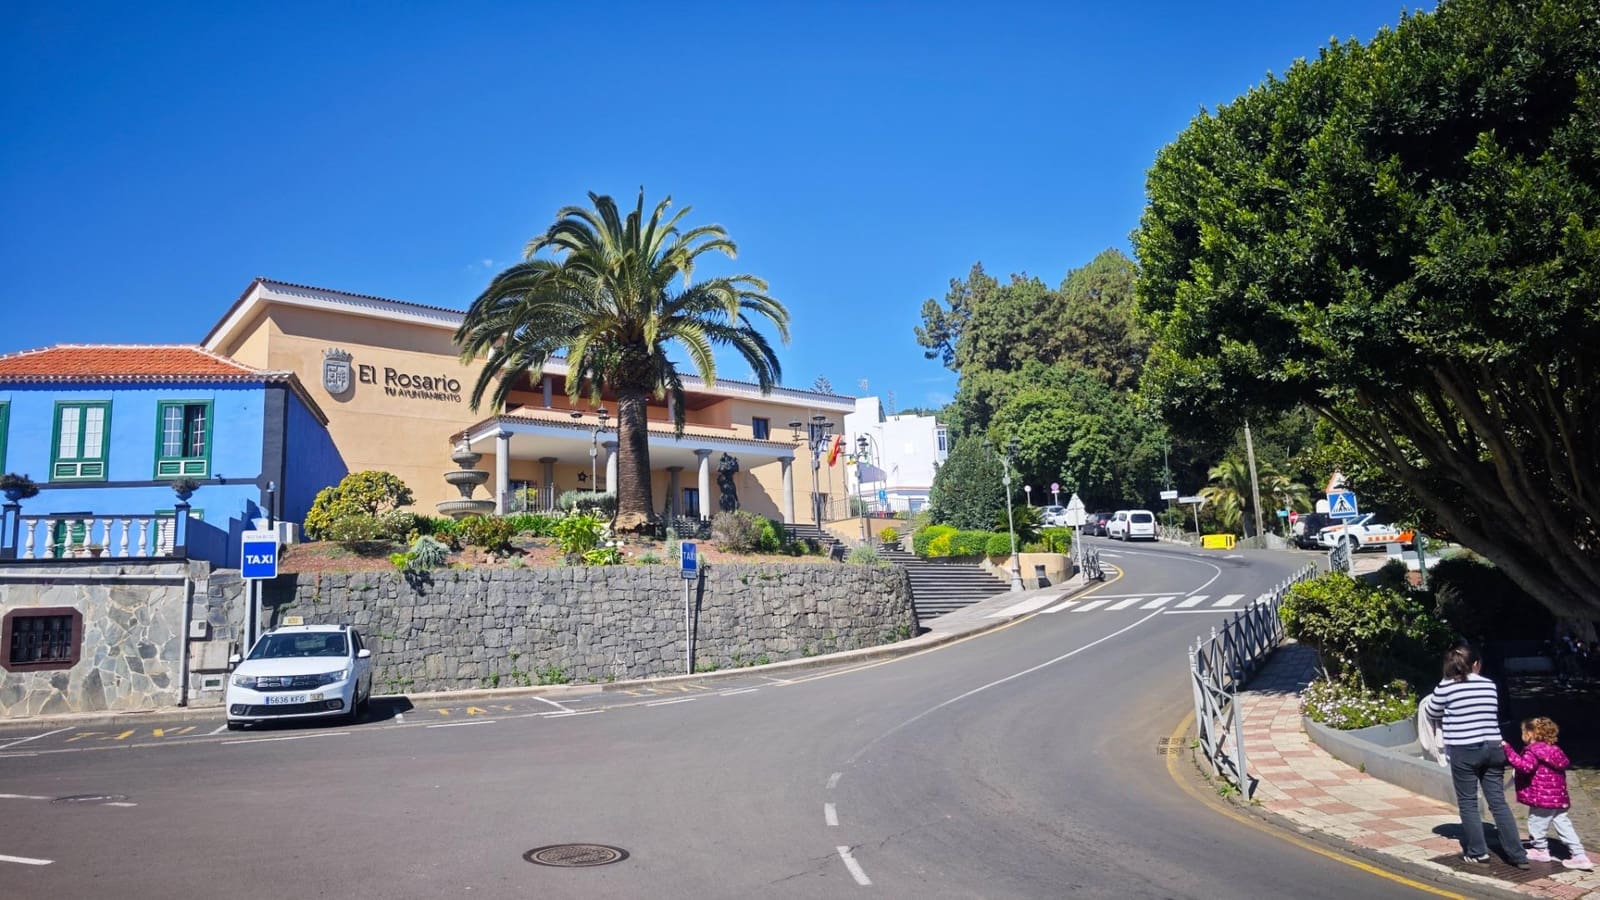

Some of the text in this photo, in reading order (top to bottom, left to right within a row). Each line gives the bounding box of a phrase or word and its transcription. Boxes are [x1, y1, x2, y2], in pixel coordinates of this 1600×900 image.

[358, 364, 462, 392] El Rosario
[384, 386, 462, 403] TU AYUNTAMIENTO
[245, 554, 273, 564] TAXI
[271, 695, 289, 704] 5636
